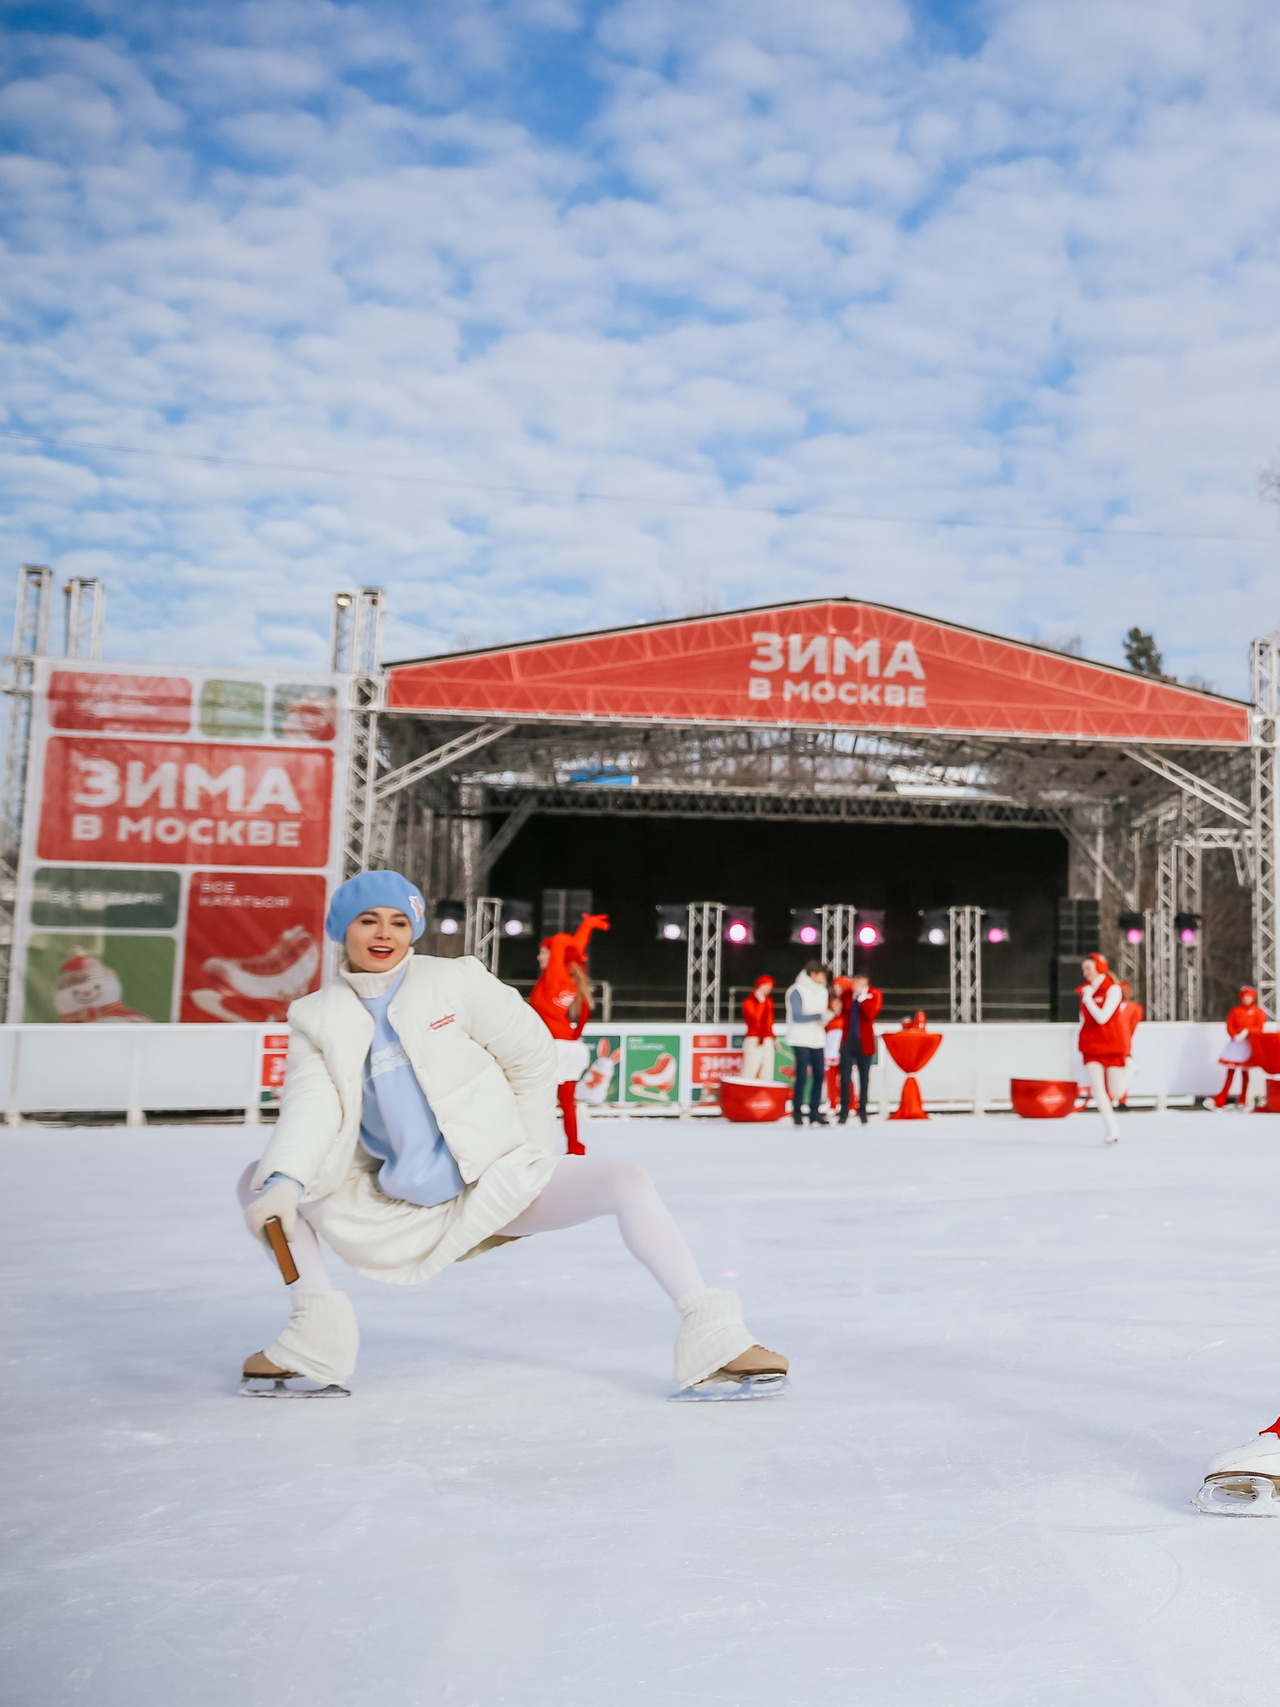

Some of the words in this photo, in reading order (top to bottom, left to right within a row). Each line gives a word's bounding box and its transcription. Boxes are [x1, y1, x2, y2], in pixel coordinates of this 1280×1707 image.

[749, 632, 927, 680] ЗИМА
[749, 677, 772, 700] В
[783, 680, 927, 708] МОСКВЕ
[74, 758, 302, 814] ЗИМА
[72, 814, 103, 842] В
[117, 816, 302, 848] МОСКВЕ
[200, 880, 236, 893] ВСЕ
